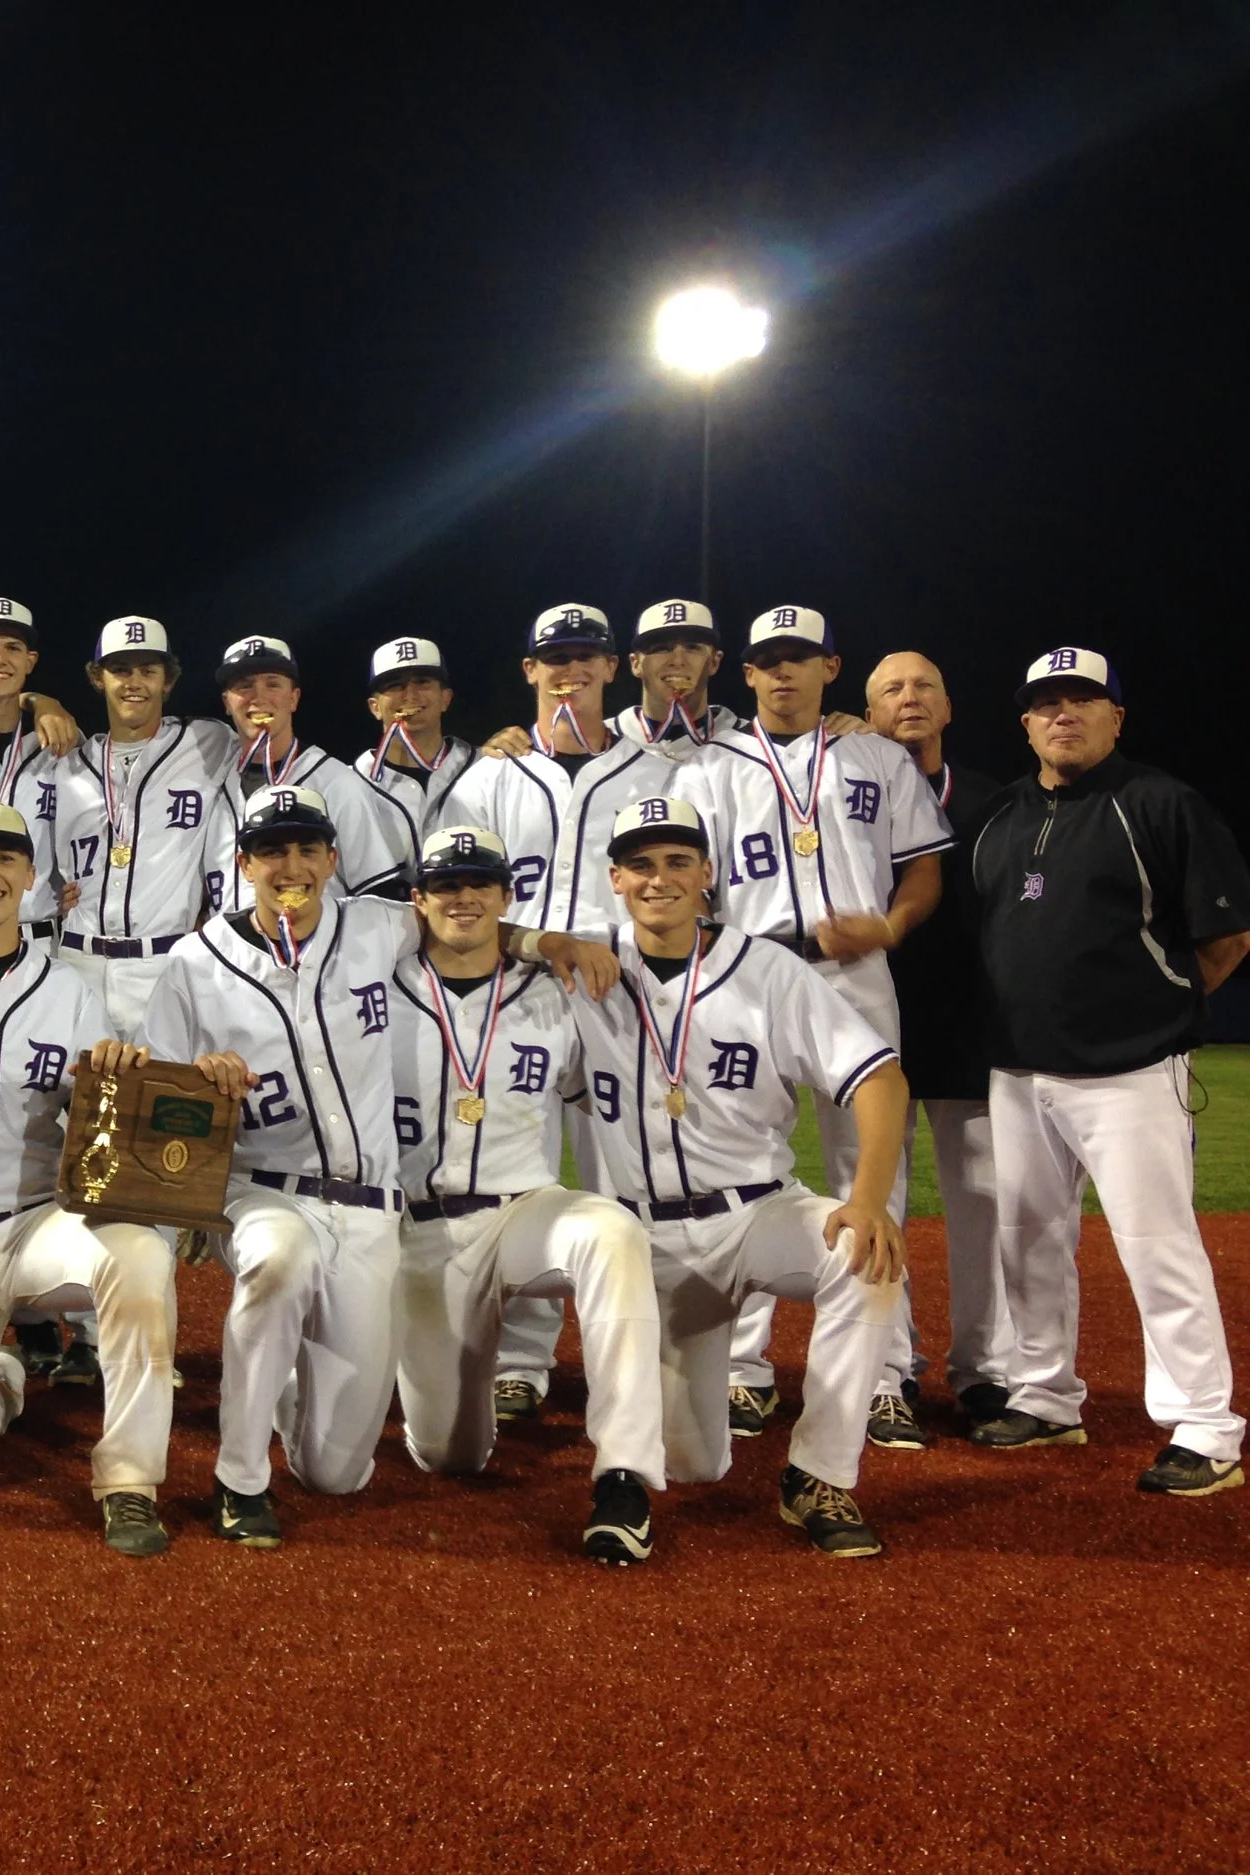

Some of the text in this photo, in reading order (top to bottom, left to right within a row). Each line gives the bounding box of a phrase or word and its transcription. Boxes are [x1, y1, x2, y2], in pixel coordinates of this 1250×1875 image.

[126, 622, 145, 644] D
[664, 603, 687, 624] D
[773, 608, 797, 628] D
[396, 642, 417, 662] D
[1047, 649, 1077, 673] D
[166, 789, 203, 830] D
[639, 799, 668, 825] D
[844, 778, 881, 824] D
[70, 835, 99, 879] 17
[512, 856, 546, 903] 2
[729, 832, 779, 884] 18
[1021, 871, 1045, 901] D
[349, 981, 388, 1038] D
[21, 1039, 67, 1093] D
[507, 1042, 550, 1094] D
[707, 1038, 759, 1090] D
[243, 1071, 297, 1131] 12
[593, 1072, 620, 1123] 9
